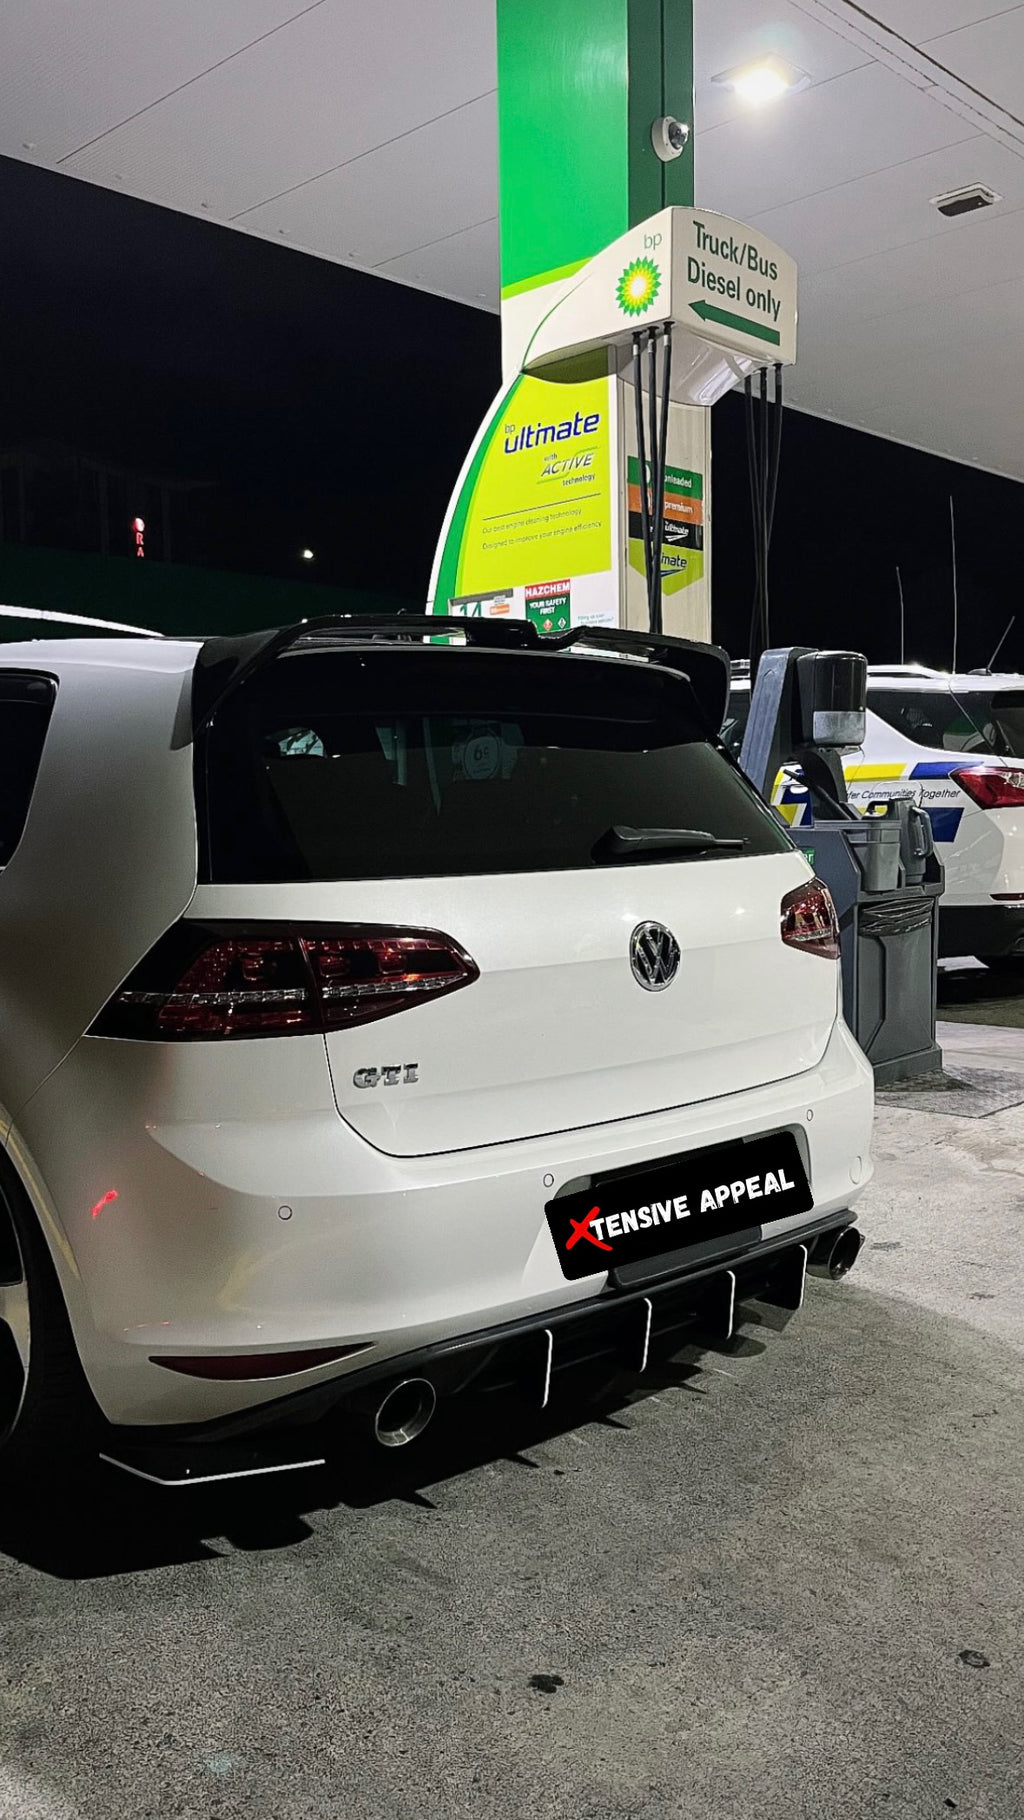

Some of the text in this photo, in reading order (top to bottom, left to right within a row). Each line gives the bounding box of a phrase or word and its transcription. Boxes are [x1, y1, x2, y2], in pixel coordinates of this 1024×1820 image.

[643, 232, 663, 250] bp
[692, 220, 778, 281] Truck/Bus
[687, 256, 781, 322] Diesel only
[504, 423, 516, 435] bp
[504, 411, 600, 454] ultimate
[544, 452, 558, 462] with
[541, 452, 595, 477] ACTIVE
[562, 473, 596, 486] technology
[664, 502, 694, 515] premium
[525, 582, 570, 598] HAZCHEM
[529, 597, 567, 610] YOUR SAFETY
[539, 606, 556, 616] FIRST
[861, 788, 917, 799] Communities
[919, 788, 961, 800] Together
[353, 1063, 419, 1089] GTI
